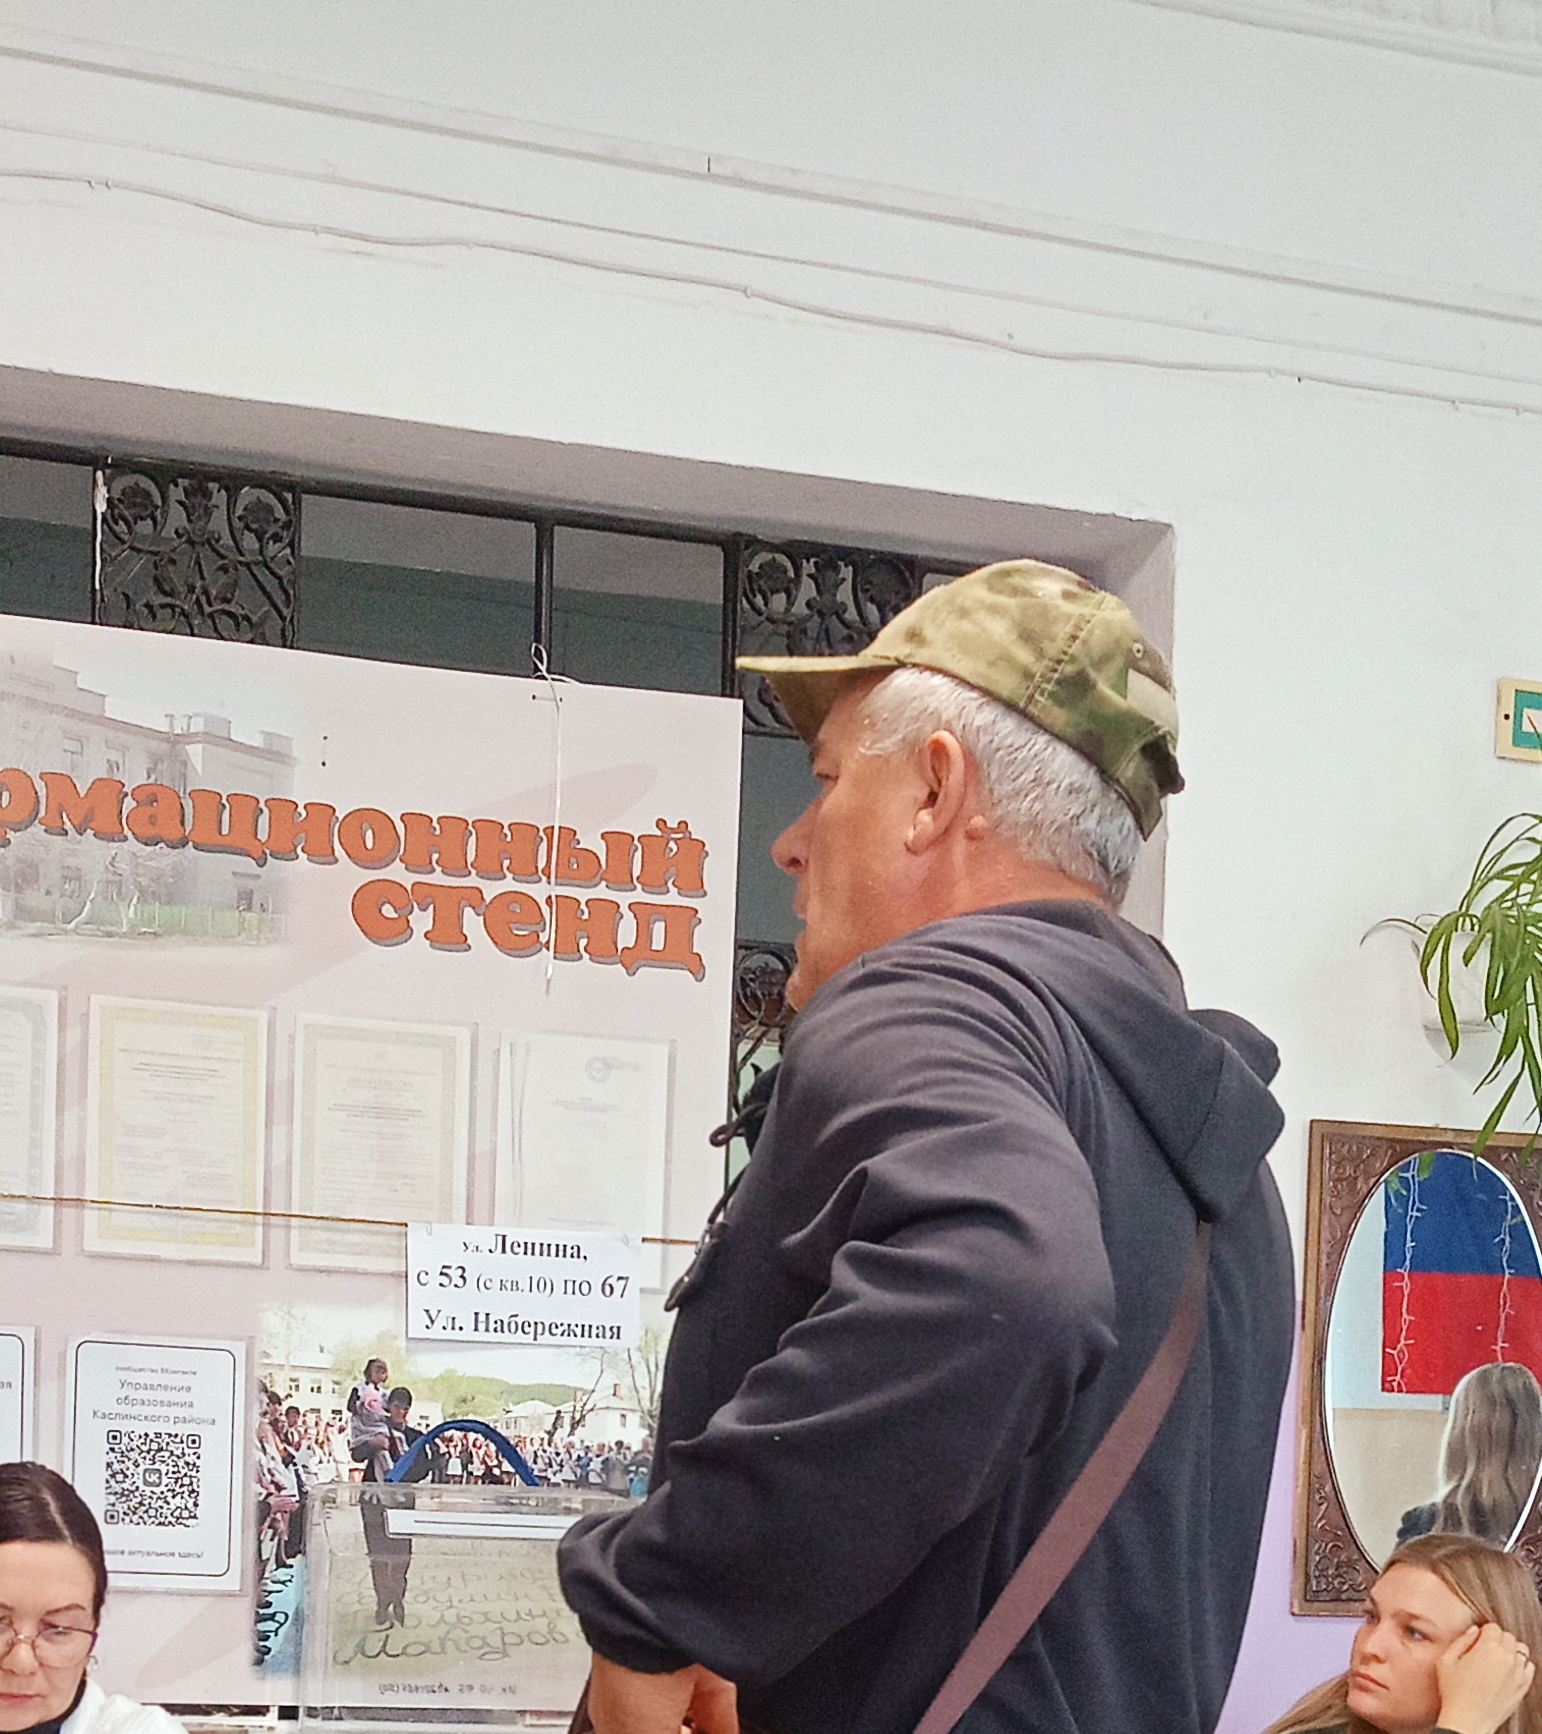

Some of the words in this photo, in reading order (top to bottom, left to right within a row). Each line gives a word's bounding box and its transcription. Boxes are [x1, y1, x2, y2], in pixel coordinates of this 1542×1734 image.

[352, 878, 705, 981] стенд
[488, 1233, 589, 1263] Ленина,
[416, 1269, 429, 1287] с
[438, 1265, 467, 1289] 53
[476, 1273, 493, 1293] (с
[498, 1275, 555, 1297] кв.10)
[563, 1279, 592, 1297] по
[600, 1275, 630, 1299] 67
[422, 1308, 464, 1332] Ул.
[472, 1311, 623, 1341] Набережная
[119, 1379, 191, 1394] Управление
[116, 1394, 194, 1410] образования
[92, 1409, 170, 1424] Каслинского
[173, 1414, 216, 1426] района
